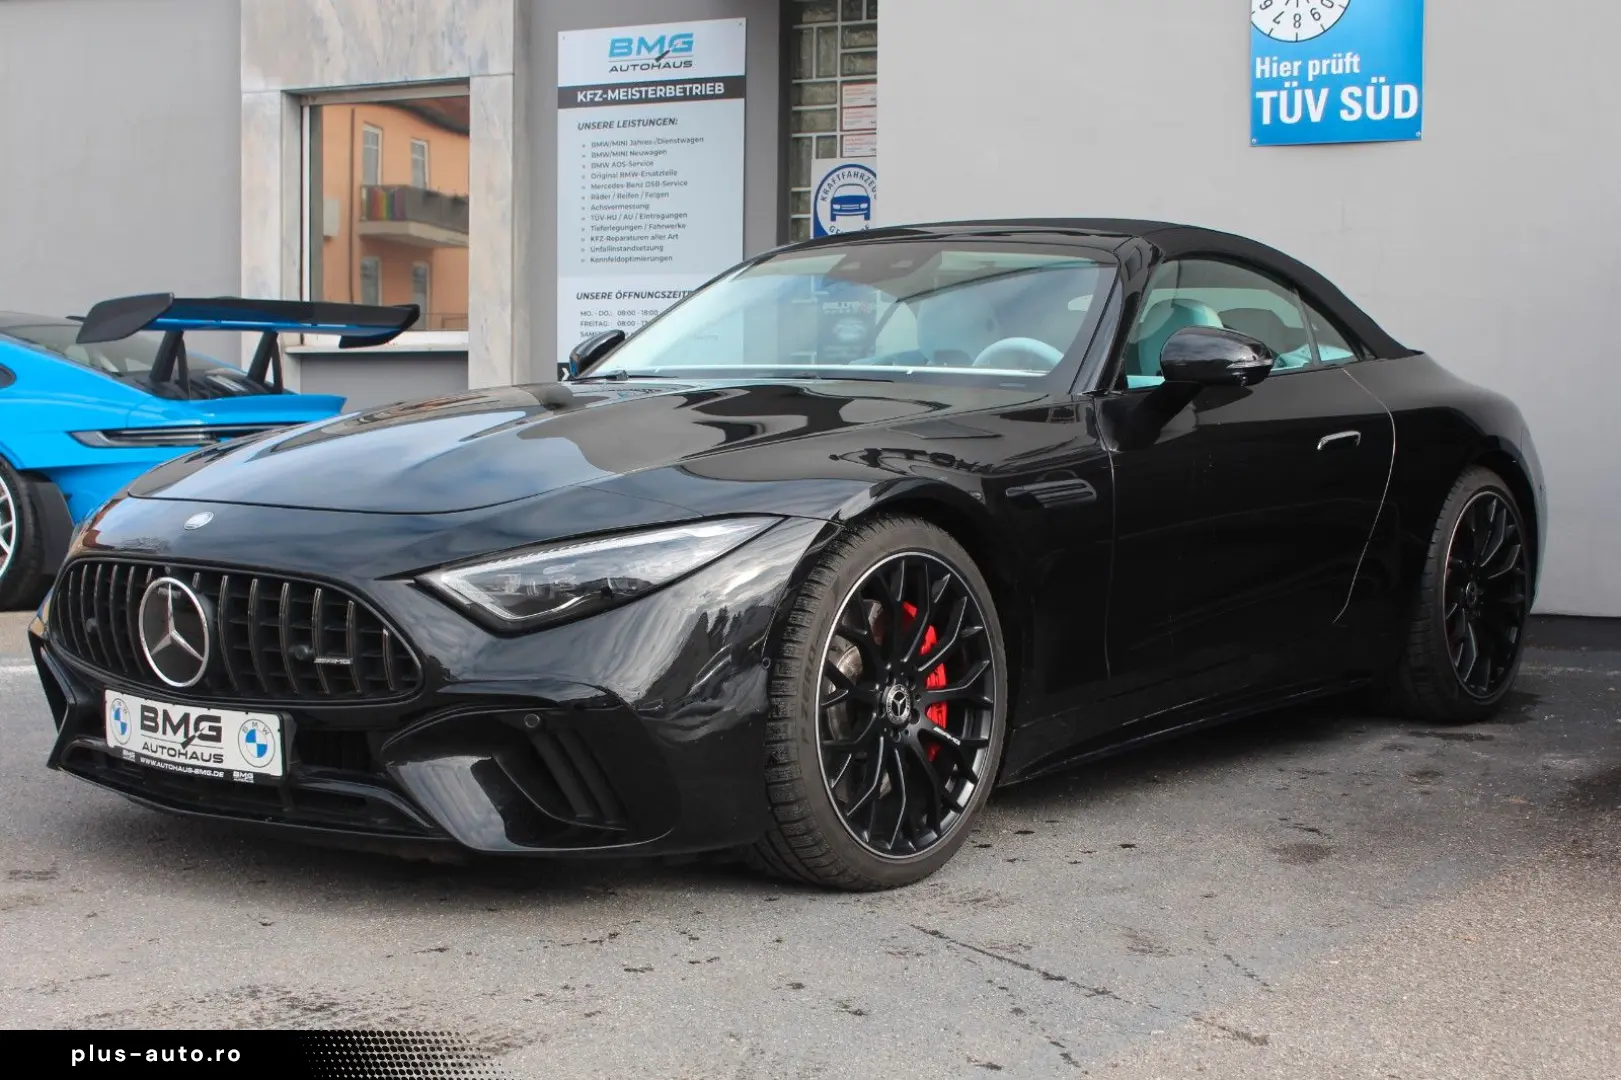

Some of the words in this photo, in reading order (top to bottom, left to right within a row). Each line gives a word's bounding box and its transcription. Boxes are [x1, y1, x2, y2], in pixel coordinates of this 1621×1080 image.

[1293, 13, 1302, 29] 8
[608, 32, 694, 58] BMG
[608, 60, 692, 73] AUTOHAUS
[1255, 56, 1302, 78] Hier
[1308, 52, 1360, 82] prüft
[577, 82, 725, 103] KFZ-MEISTERBETRIEB
[1255, 81, 1330, 125] TÜV
[1340, 76, 1418, 121] SÜD
[577, 120, 615, 131] UNSERE
[616, 117, 678, 129] LEISTUNGEN:
[629, 149, 667, 157] Neuwagen
[590, 172, 618, 180] Original
[645, 191, 669, 199] Felgen
[591, 203, 650, 212] Achsvermessung
[639, 212, 688, 221] Eintragungen
[590, 224, 643, 233] Tieferlegungen
[590, 244, 664, 253] Unfallinstandsetzung
[590, 255, 673, 264] Kennfeldoptimierungen
[576, 292, 613, 300] UNSERE
[141, 704, 222, 744] BMG
[142, 742, 224, 763] AUTOHAUS
[140, 758, 224, 777] WWW.AUTOHAUS-BMG.DE
